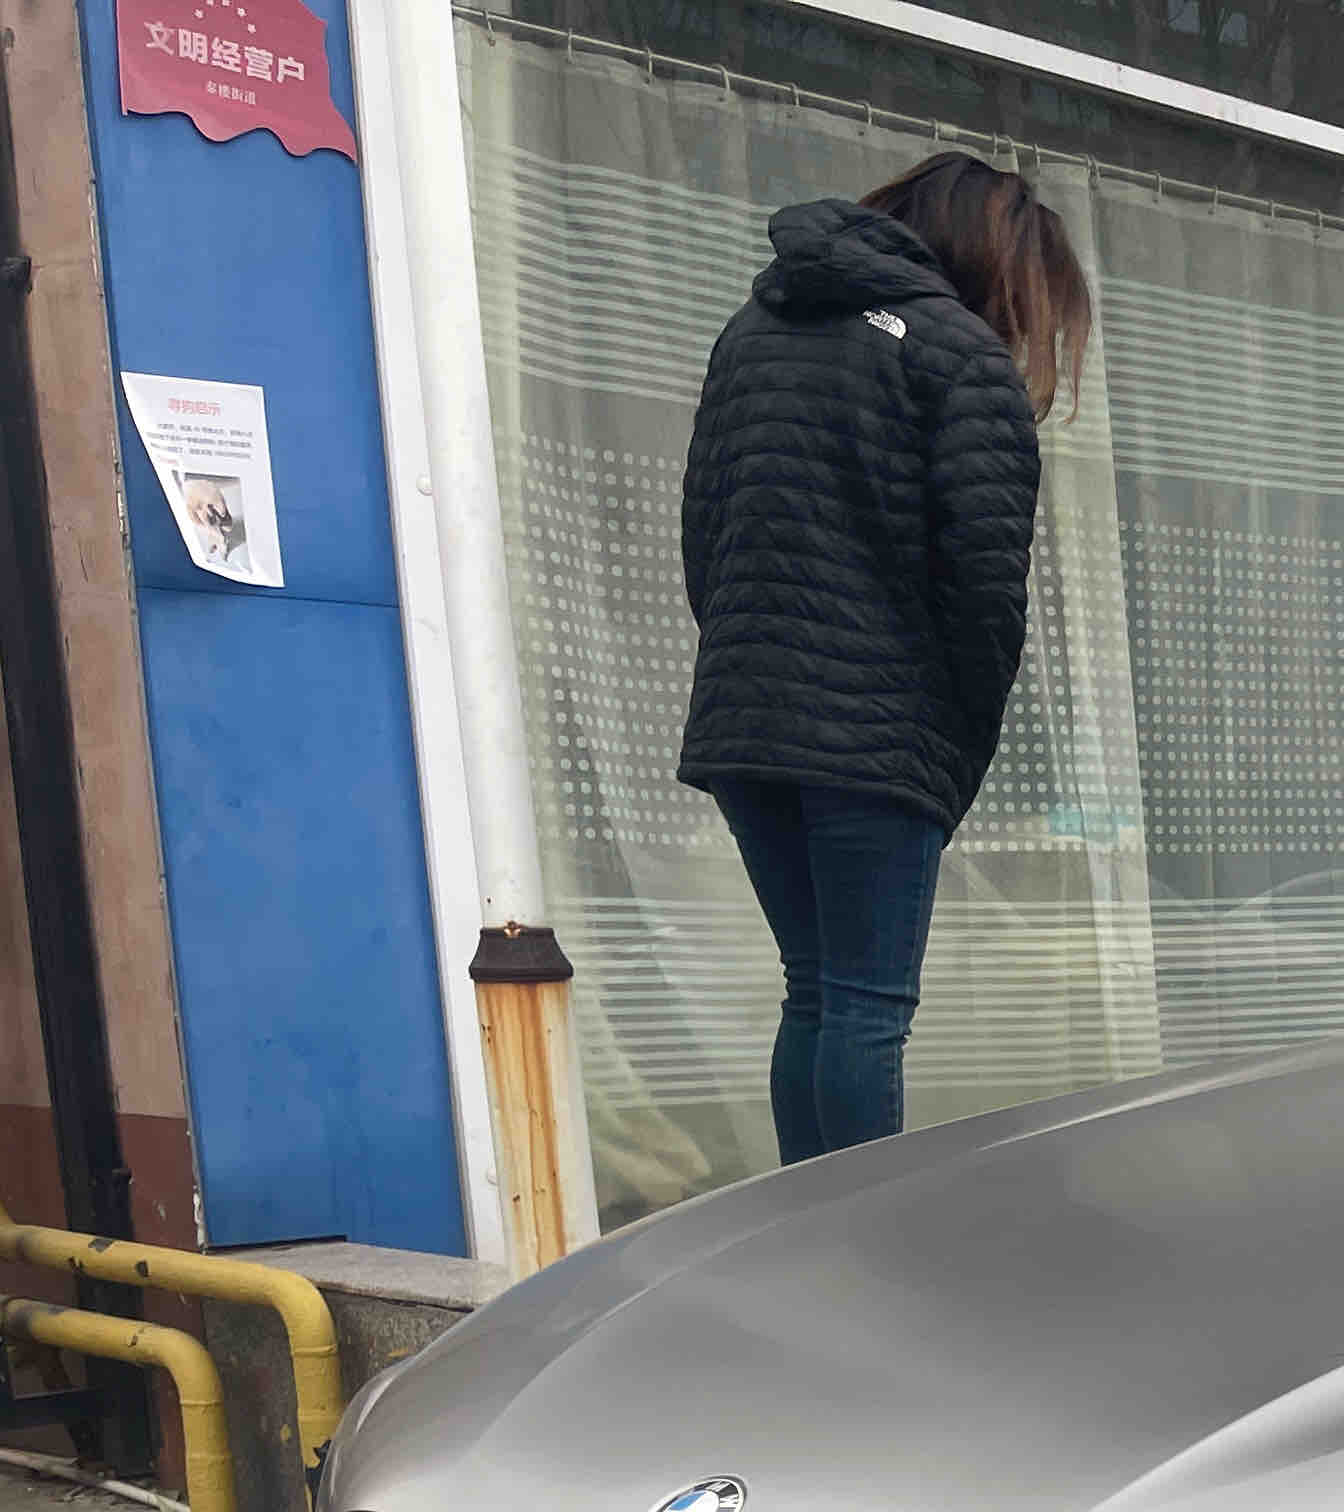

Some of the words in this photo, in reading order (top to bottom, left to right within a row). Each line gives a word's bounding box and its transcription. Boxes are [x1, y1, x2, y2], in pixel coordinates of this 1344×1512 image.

[143, 20, 305, 84] 文明经营户
